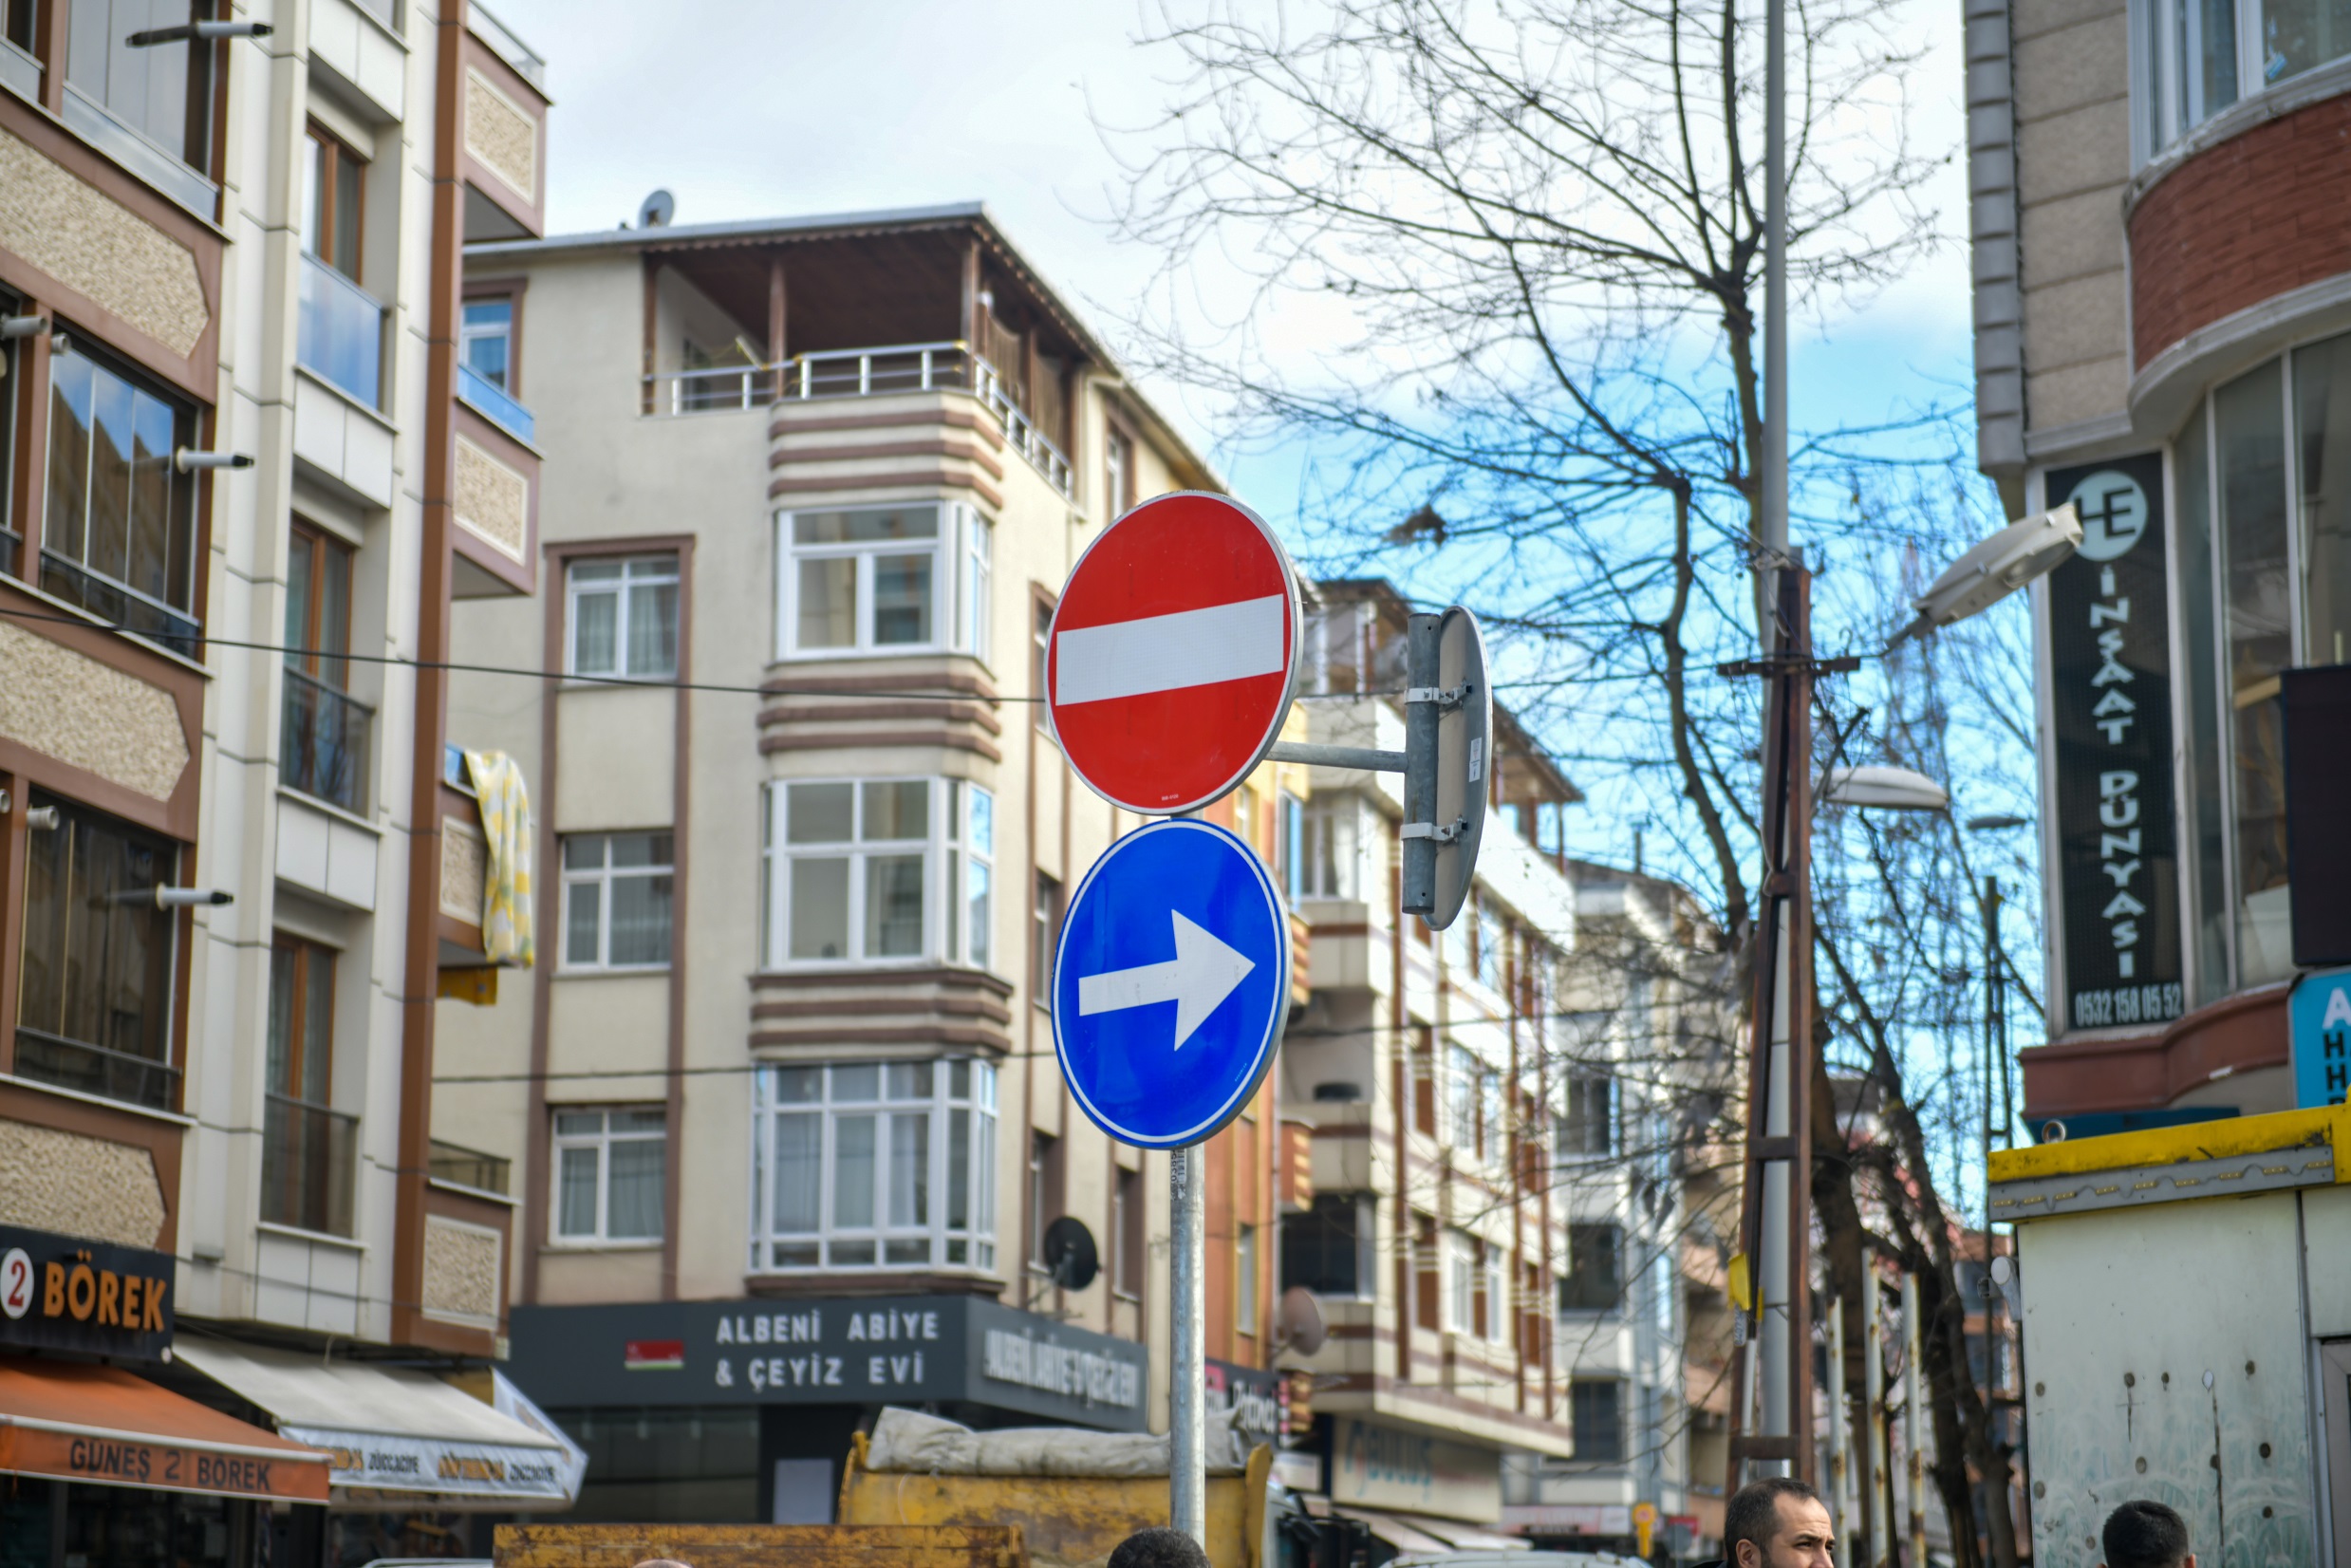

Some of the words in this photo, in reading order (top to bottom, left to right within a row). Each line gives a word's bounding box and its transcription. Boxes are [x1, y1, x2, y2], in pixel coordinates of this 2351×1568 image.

[2099, 770, 2146, 979] DÜNYASI
[2075, 989, 2112, 1027] 0532
[2114, 986, 2139, 1023] 158
[2142, 984, 2161, 1020] 05
[2163, 981, 2181, 1018] 52
[8, 1260, 27, 1308] 2
[44, 1248, 167, 1333] BÖREK
[716, 1308, 821, 1344] ALBENİ
[847, 1307, 940, 1340] ABİYE
[715, 1357, 734, 1387] &
[748, 1352, 843, 1393] ÇEYİZ
[868, 1349, 924, 1384] EVİ
[69, 1437, 151, 1481] GÜNEŞ
[164, 1449, 182, 1481] 2
